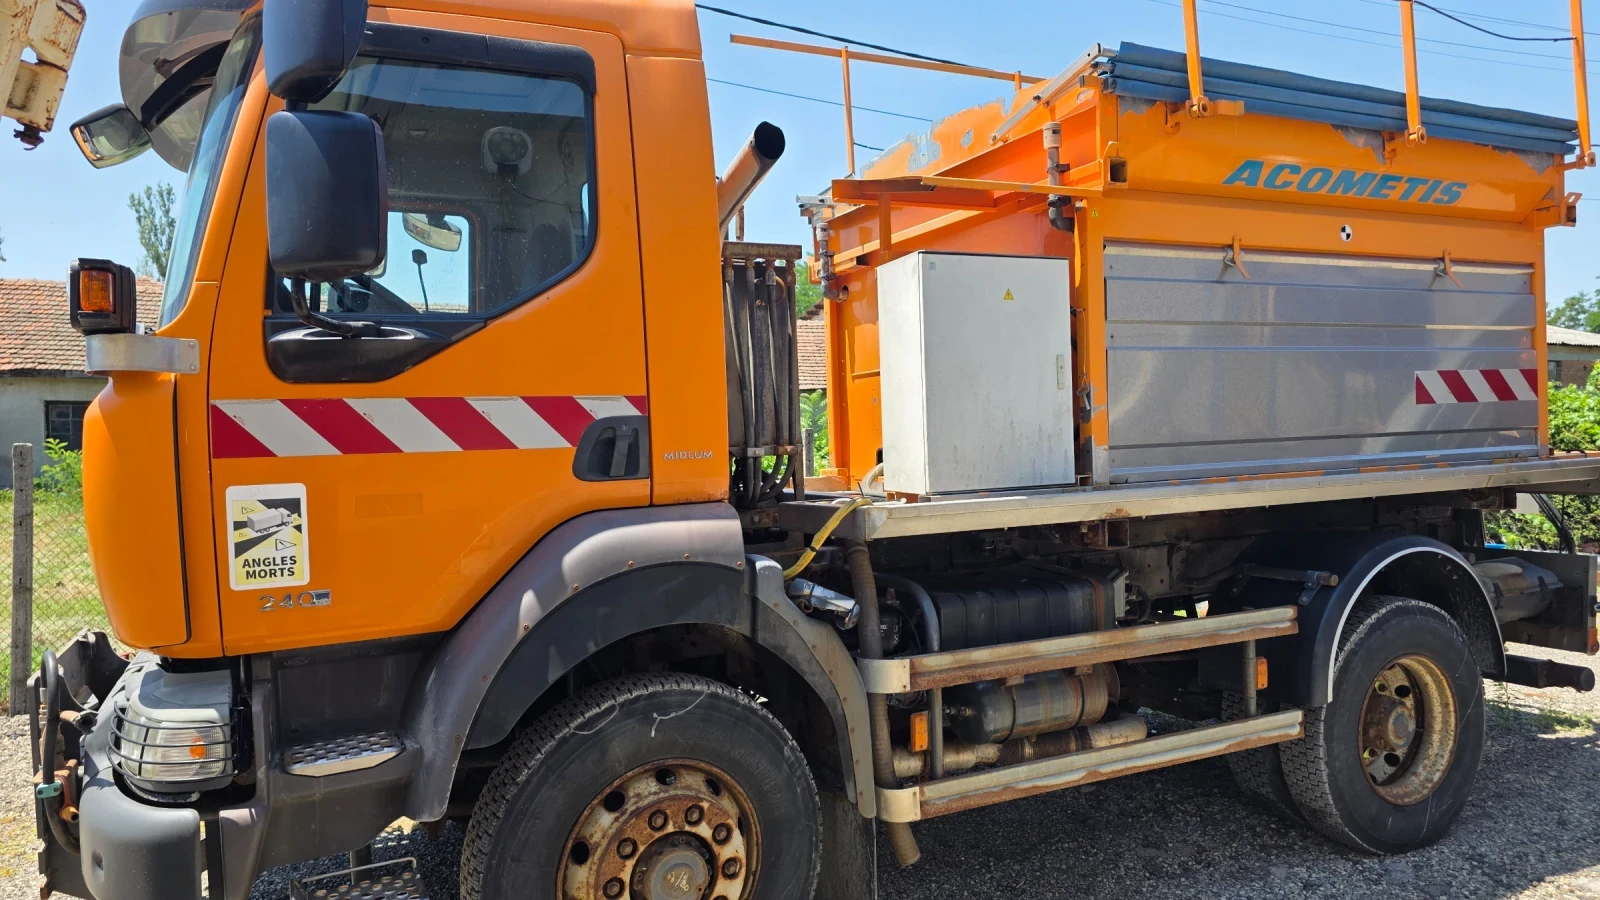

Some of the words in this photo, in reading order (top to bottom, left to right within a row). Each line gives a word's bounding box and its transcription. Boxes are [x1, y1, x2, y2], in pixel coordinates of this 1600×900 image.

[1221, 159, 1467, 205] ACOMETIS
[663, 450, 713, 461] MIDLUM
[242, 555, 296, 568] ANGLES
[246, 567, 295, 579] MORTS
